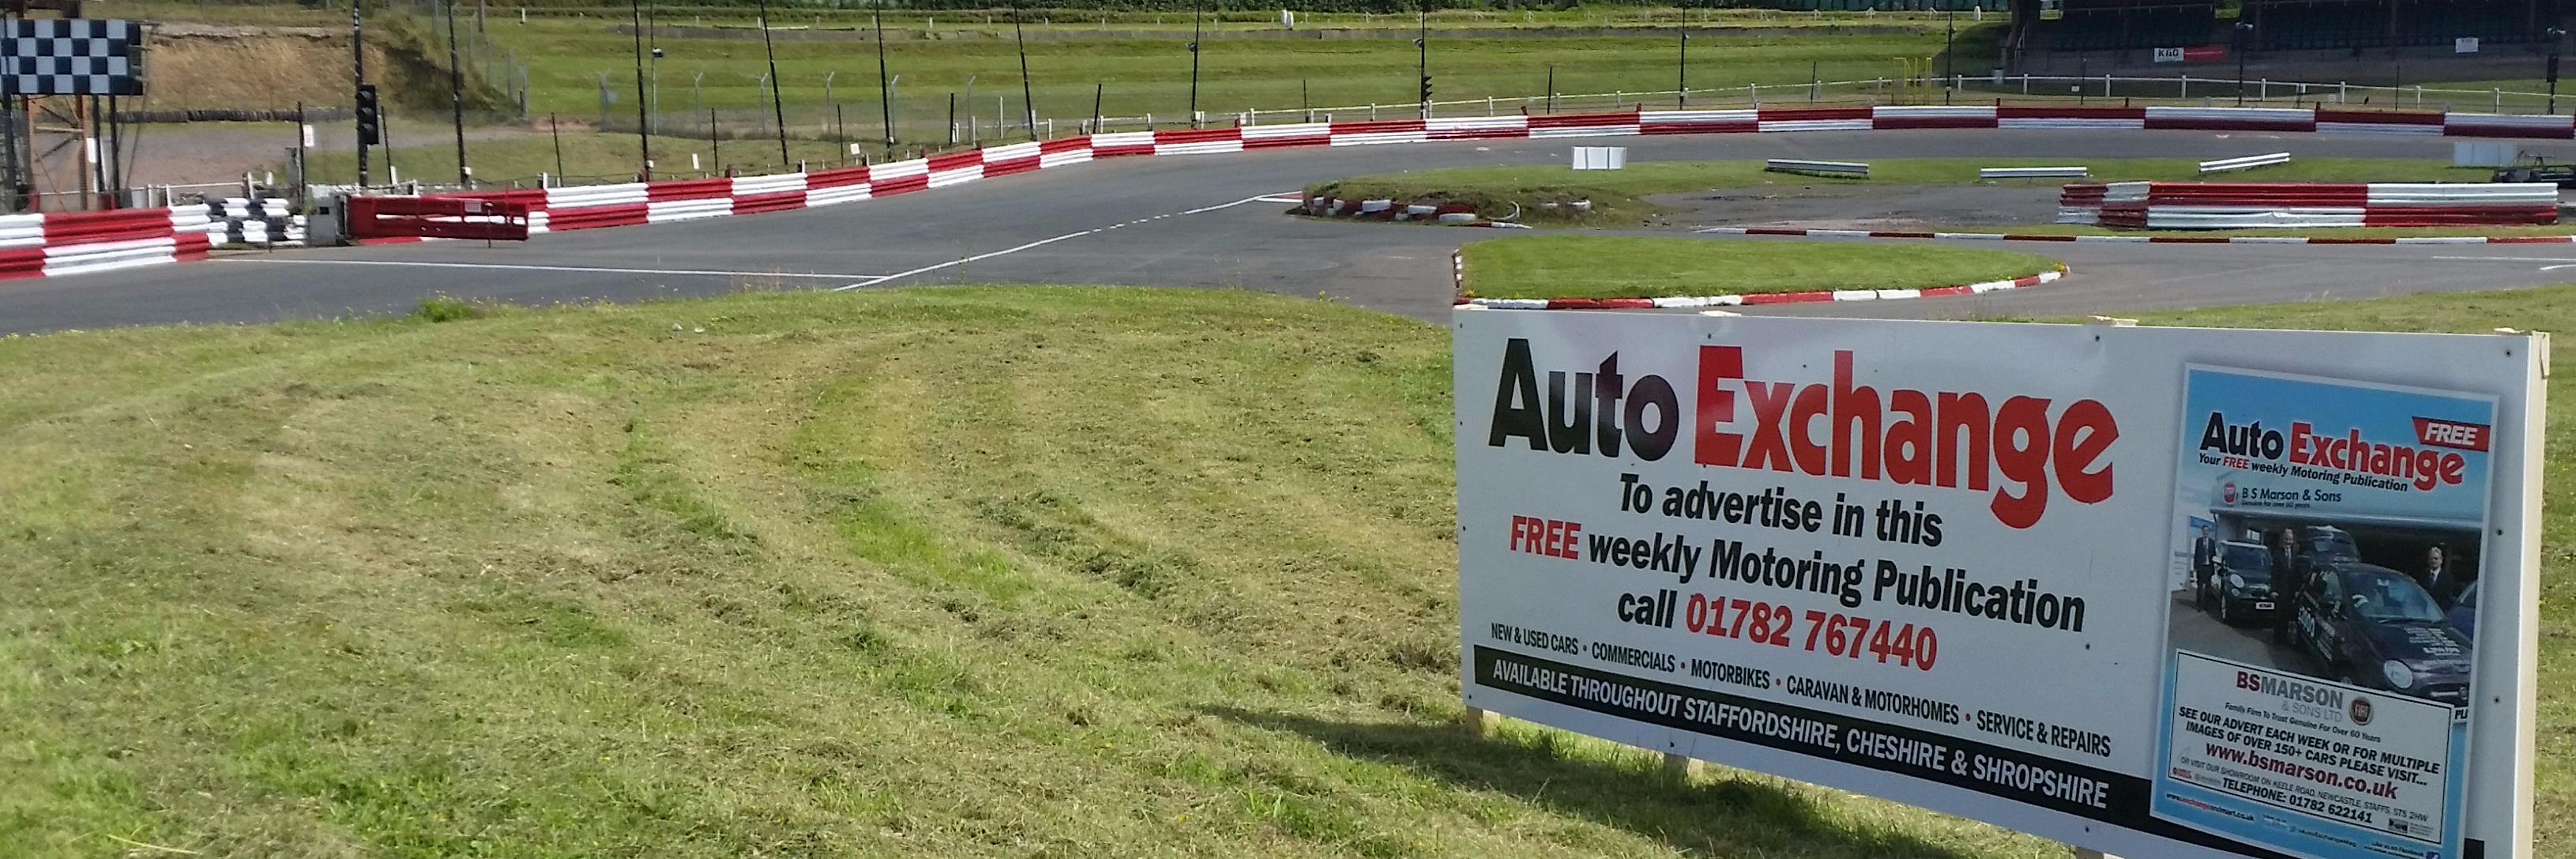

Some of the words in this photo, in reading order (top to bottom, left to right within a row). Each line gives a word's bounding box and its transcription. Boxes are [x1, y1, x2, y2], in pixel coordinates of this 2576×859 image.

[1489, 337, 1679, 462] Auto
[1694, 345, 2120, 529] Exchange
[2199, 411, 2284, 460] Auto
[2289, 421, 2465, 491] Exchange
[2424, 422, 2479, 446] FREE
[2198, 452, 2221, 468] Your
[2223, 457, 2249, 470] FREE
[2251, 461, 2288, 477] weekly
[2290, 466, 2341, 485] Motoring
[2343, 472, 2409, 492] Publication
[2242, 488, 2248, 499] B
[2251, 488, 2257, 499] S
[2259, 488, 2299, 500] Marson
[2303, 489, 2311, 501] &
[2314, 489, 2341, 502] Sons
[1620, 473, 1653, 514] To
[1662, 480, 1822, 533] advertise
[1833, 493, 1863, 537] in
[1876, 500, 1942, 548] this
[1510, 515, 1581, 560] FREE
[1588, 532, 1702, 584] weekly
[1709, 539, 1864, 608] Motoring
[1874, 559, 2086, 633] Publication
[1618, 589, 1675, 630] call
[1686, 593, 1793, 646] 01782
[1803, 611, 1938, 672] 767440
[1491, 623, 1513, 641] NEW
[1514, 627, 1521, 644] &
[1523, 628, 1550, 650] USED
[1551, 634, 1578, 655] CARS
[1592, 642, 1675, 673] COMMERCIALS
[1691, 658, 1771, 690] MOTORBIKES
[1787, 675, 1848, 705] CARAVAN
[1852, 686, 1861, 707] &
[1865, 688, 1959, 725] MOTORHOMES
[1976, 709, 2034, 741] SERVICE
[2036, 721, 2048, 744] &
[2051, 725, 2112, 759] REPAIRS
[2236, 670, 2344, 709] BSMARSON
[2281, 700, 2289, 711] &
[2293, 703, 2321, 718] SONS
[2324, 710, 2343, 722] LTD
[1493, 658, 1568, 695] AVAILABLE
[1570, 673, 1682, 718] THROUGHOUT
[1683, 697, 1841, 755] STAFFORDSHIRE,
[1846, 727, 1946, 771] CHESHIRE
[1950, 750, 1968, 777] &
[1972, 753, 2110, 809] SHROPSHIRE
[2179, 706, 2198, 721] SEE
[2200, 710, 2221, 725] OUR
[2222, 715, 2264, 737] ADVERT
[2266, 725, 2296, 743] EACH
[2296, 731, 2330, 751] WEEK
[2333, 740, 2350, 755] OR
[2352, 744, 2378, 761] FOR
[2379, 751, 2441, 775] MULTIPLE
[2186, 721, 2225, 740] IMAGES
[2227, 729, 2243, 744] OF
[2243, 733, 2272, 751] OVER
[2273, 740, 2303, 758] 150+
[2305, 748, 2337, 766] CARS
[2339, 755, 2386, 776] PLEASE
[2387, 766, 2428, 786] VISIT...
[2224, 702, 2245, 713] Family
[2247, 706, 2262, 717] Firm
[2263, 710, 2271, 719] To
[2272, 713, 2288, 723] Trust
[2289, 716, 2318, 730] Genuine
[2318, 723, 2331, 732] For
[2332, 725, 2348, 737] Over
[2361, 732, 2381, 743] Years
[2180, 756, 2190, 765] OR
[2191, 759, 2206, 768] VISIT
[2206, 763, 2220, 773] OUR
[2221, 767, 2260, 783] SHOWROOM
[2261, 777, 2272, 786] ON
[2206, 741, 2398, 801] www.bsmarson.co.uk
[2222, 777, 2287, 803] TELEPHONE:
[2289, 794, 2325, 812] 01782
[2328, 804, 2373, 823] 622141
